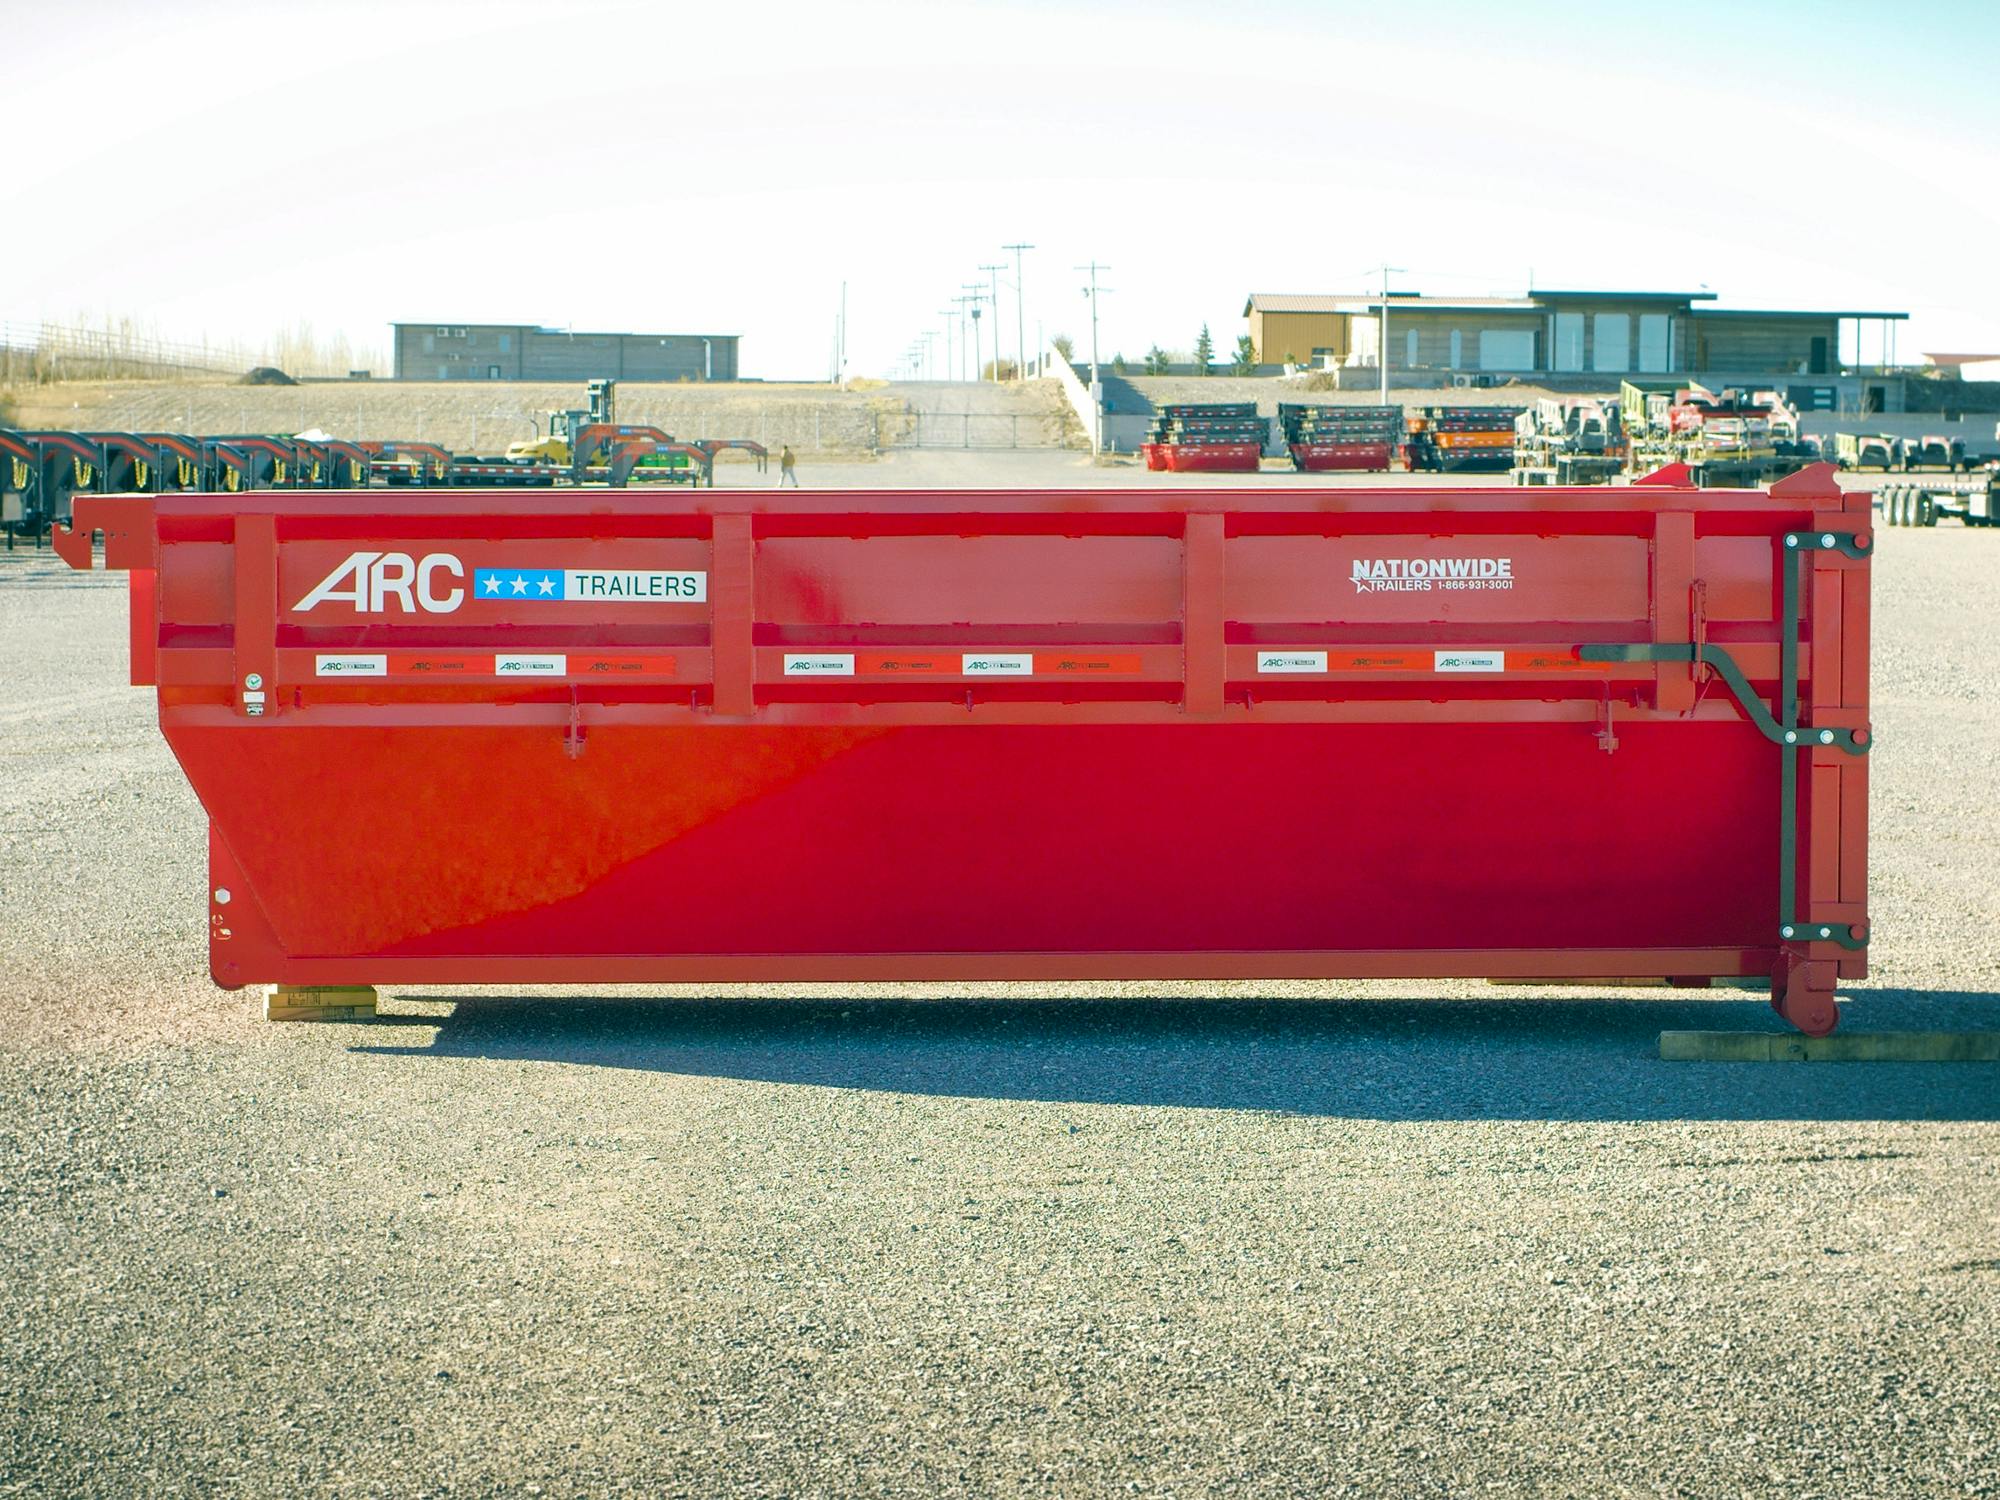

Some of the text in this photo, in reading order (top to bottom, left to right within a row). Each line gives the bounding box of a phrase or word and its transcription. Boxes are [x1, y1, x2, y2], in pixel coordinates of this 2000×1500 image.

[1352, 558, 1512, 577] NATIONWIDE
[291, 552, 696, 613] ARC TRAILERS
[1369, 580, 1513, 591] TRAILERS 1-866-931-3001
[321, 662, 342, 671] ARC
[500, 662, 521, 671] ARC
[789, 662, 810, 670] ARC
[967, 661, 988, 670] ARC
[1262, 658, 1284, 667] ARC
[1439, 658, 1460, 667] ARC
